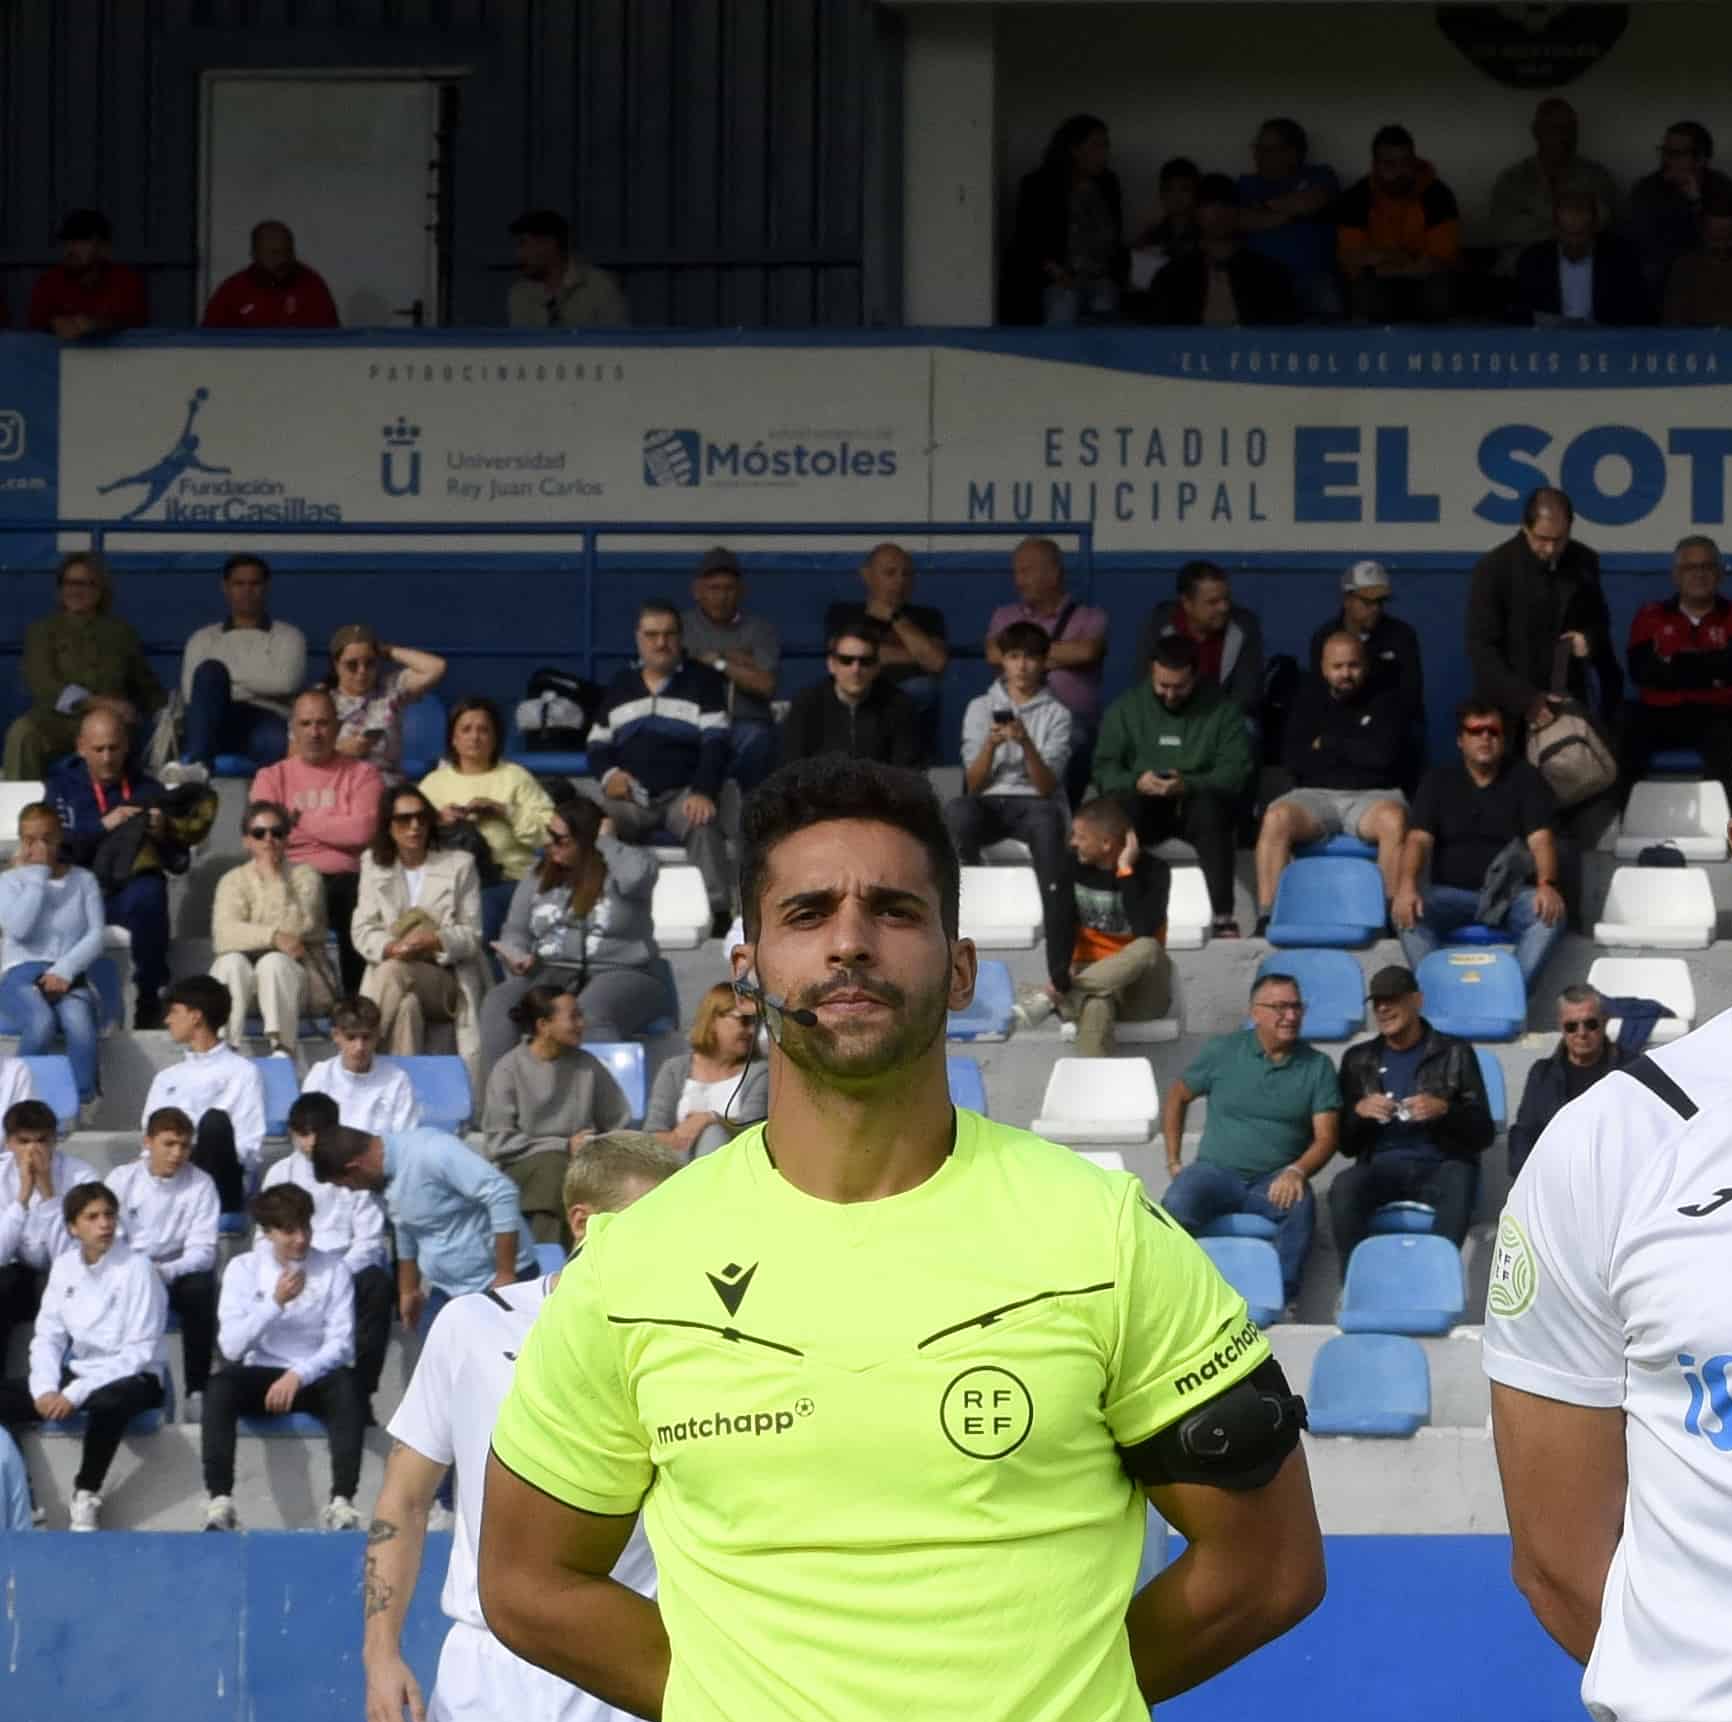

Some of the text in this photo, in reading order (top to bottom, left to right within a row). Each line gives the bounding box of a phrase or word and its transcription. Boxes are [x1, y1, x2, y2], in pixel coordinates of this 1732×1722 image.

[448, 450, 566, 471] Universidad
[706, 441, 897, 476] Móstoles
[1045, 427, 1268, 467] ESTADIO
[180, 476, 285, 497] Fundación
[448, 478, 604, 500] Rey Juan Carlos
[1293, 426, 1440, 523] EL
[968, 481, 1266, 521] MUNICIPAL
[657, 1410, 794, 1445] matchapp
